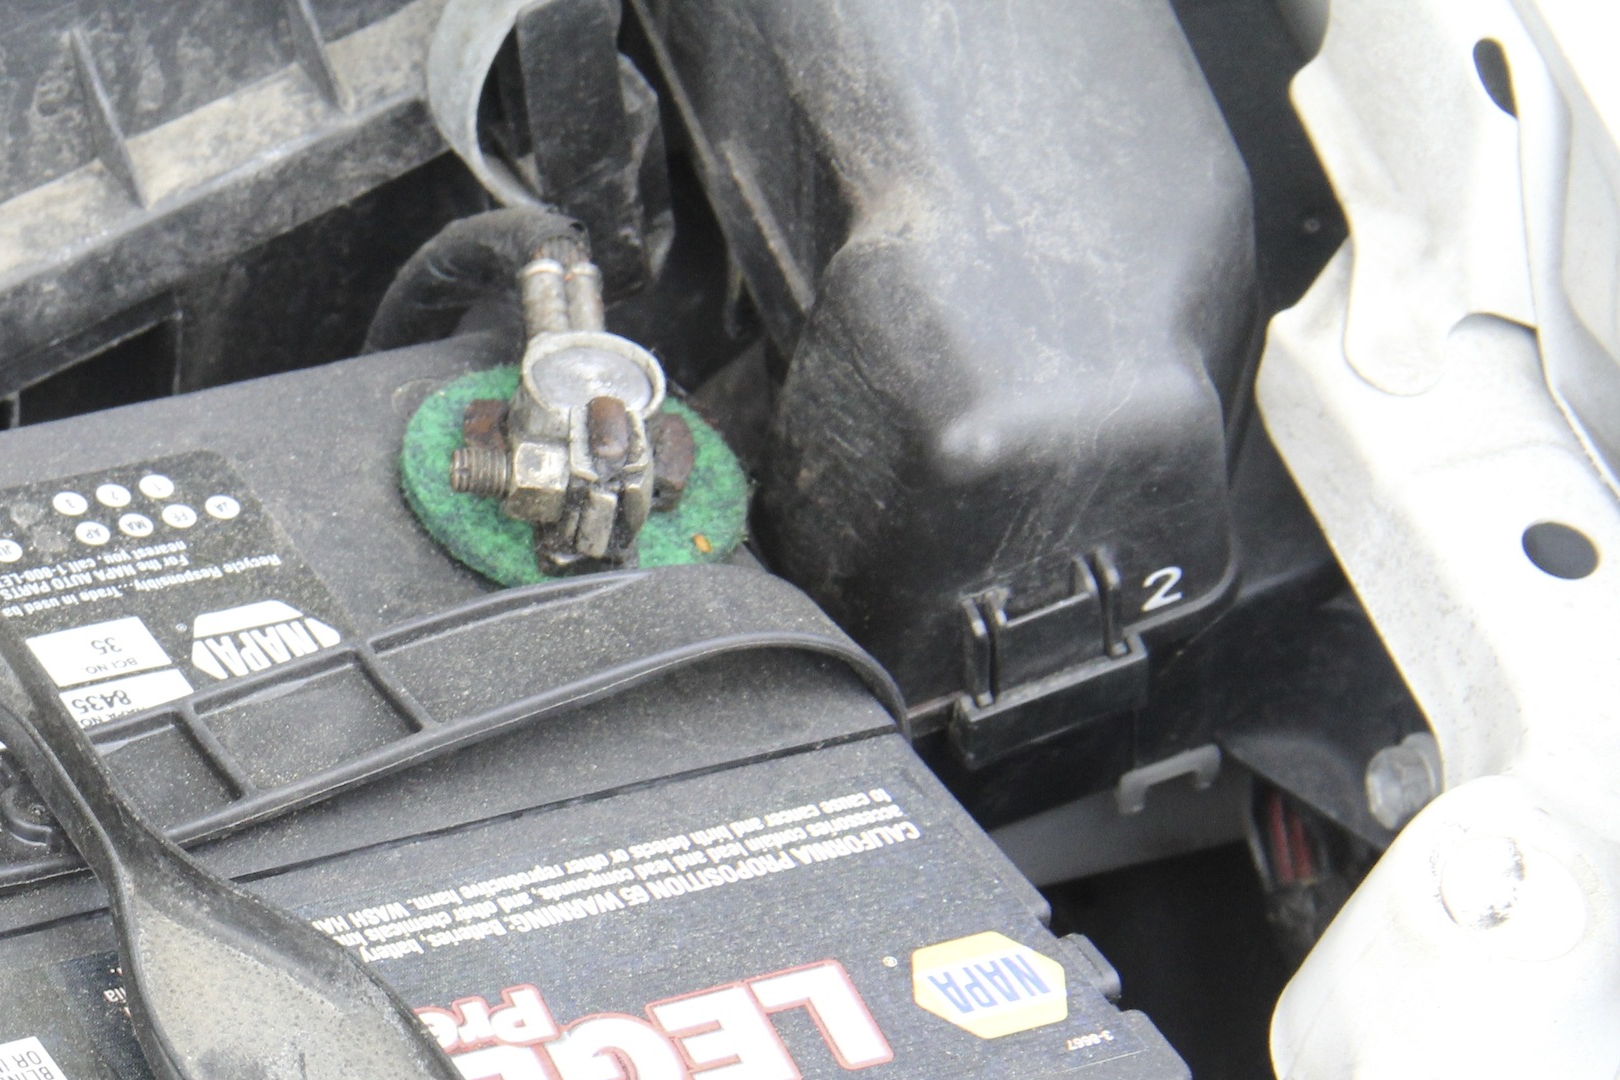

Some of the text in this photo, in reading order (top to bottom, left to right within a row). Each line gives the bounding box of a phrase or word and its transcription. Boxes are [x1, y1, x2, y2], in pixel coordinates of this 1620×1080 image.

[131, 540, 187, 560] nearest
[163, 554, 189, 567] For
[67, 558, 96, 573] call
[92, 564, 137, 581] NAPA
[136, 559, 162, 571] the
[223, 554, 281, 573] Recycle
[0, 581, 51, 600] PARTS
[51, 572, 92, 590] AUTO
[1142, 566, 1182, 611] 2
[23, 597, 60, 614] used
[61, 594, 79, 605] in
[91, 638, 122, 654] 35
[204, 620, 319, 677] NAPA
[111, 657, 138, 669] BCI
[71, 689, 132, 714] 8435
[819, 792, 871, 814] cause
[869, 788, 892, 802] to
[764, 804, 821, 827] cancer
[805, 804, 904, 837] accessories
[689, 825, 734, 846] birth
[729, 817, 765, 837] and
[628, 834, 691, 859] defects
[744, 827, 808, 852] contain
[609, 849, 630, 864] or
[672, 850, 707, 871] and
[706, 842, 749, 863] lead
[564, 853, 609, 874] other
[633, 858, 677, 880] lead
[359, 821, 920, 963] CALIFORNIA PROPOSITION 65 WARNING: Batteries, battery
[459, 864, 565, 899] reproductive
[530, 867, 635, 901] compounds,
[406, 889, 463, 910] harm.
[496, 892, 533, 913] and
[348, 902, 411, 928] WASH
[452, 900, 498, 923] other
[364, 911, 452, 942] chemicals
[927, 953, 1051, 1015] NAPA
[12, 1051, 42, 1068] OR
